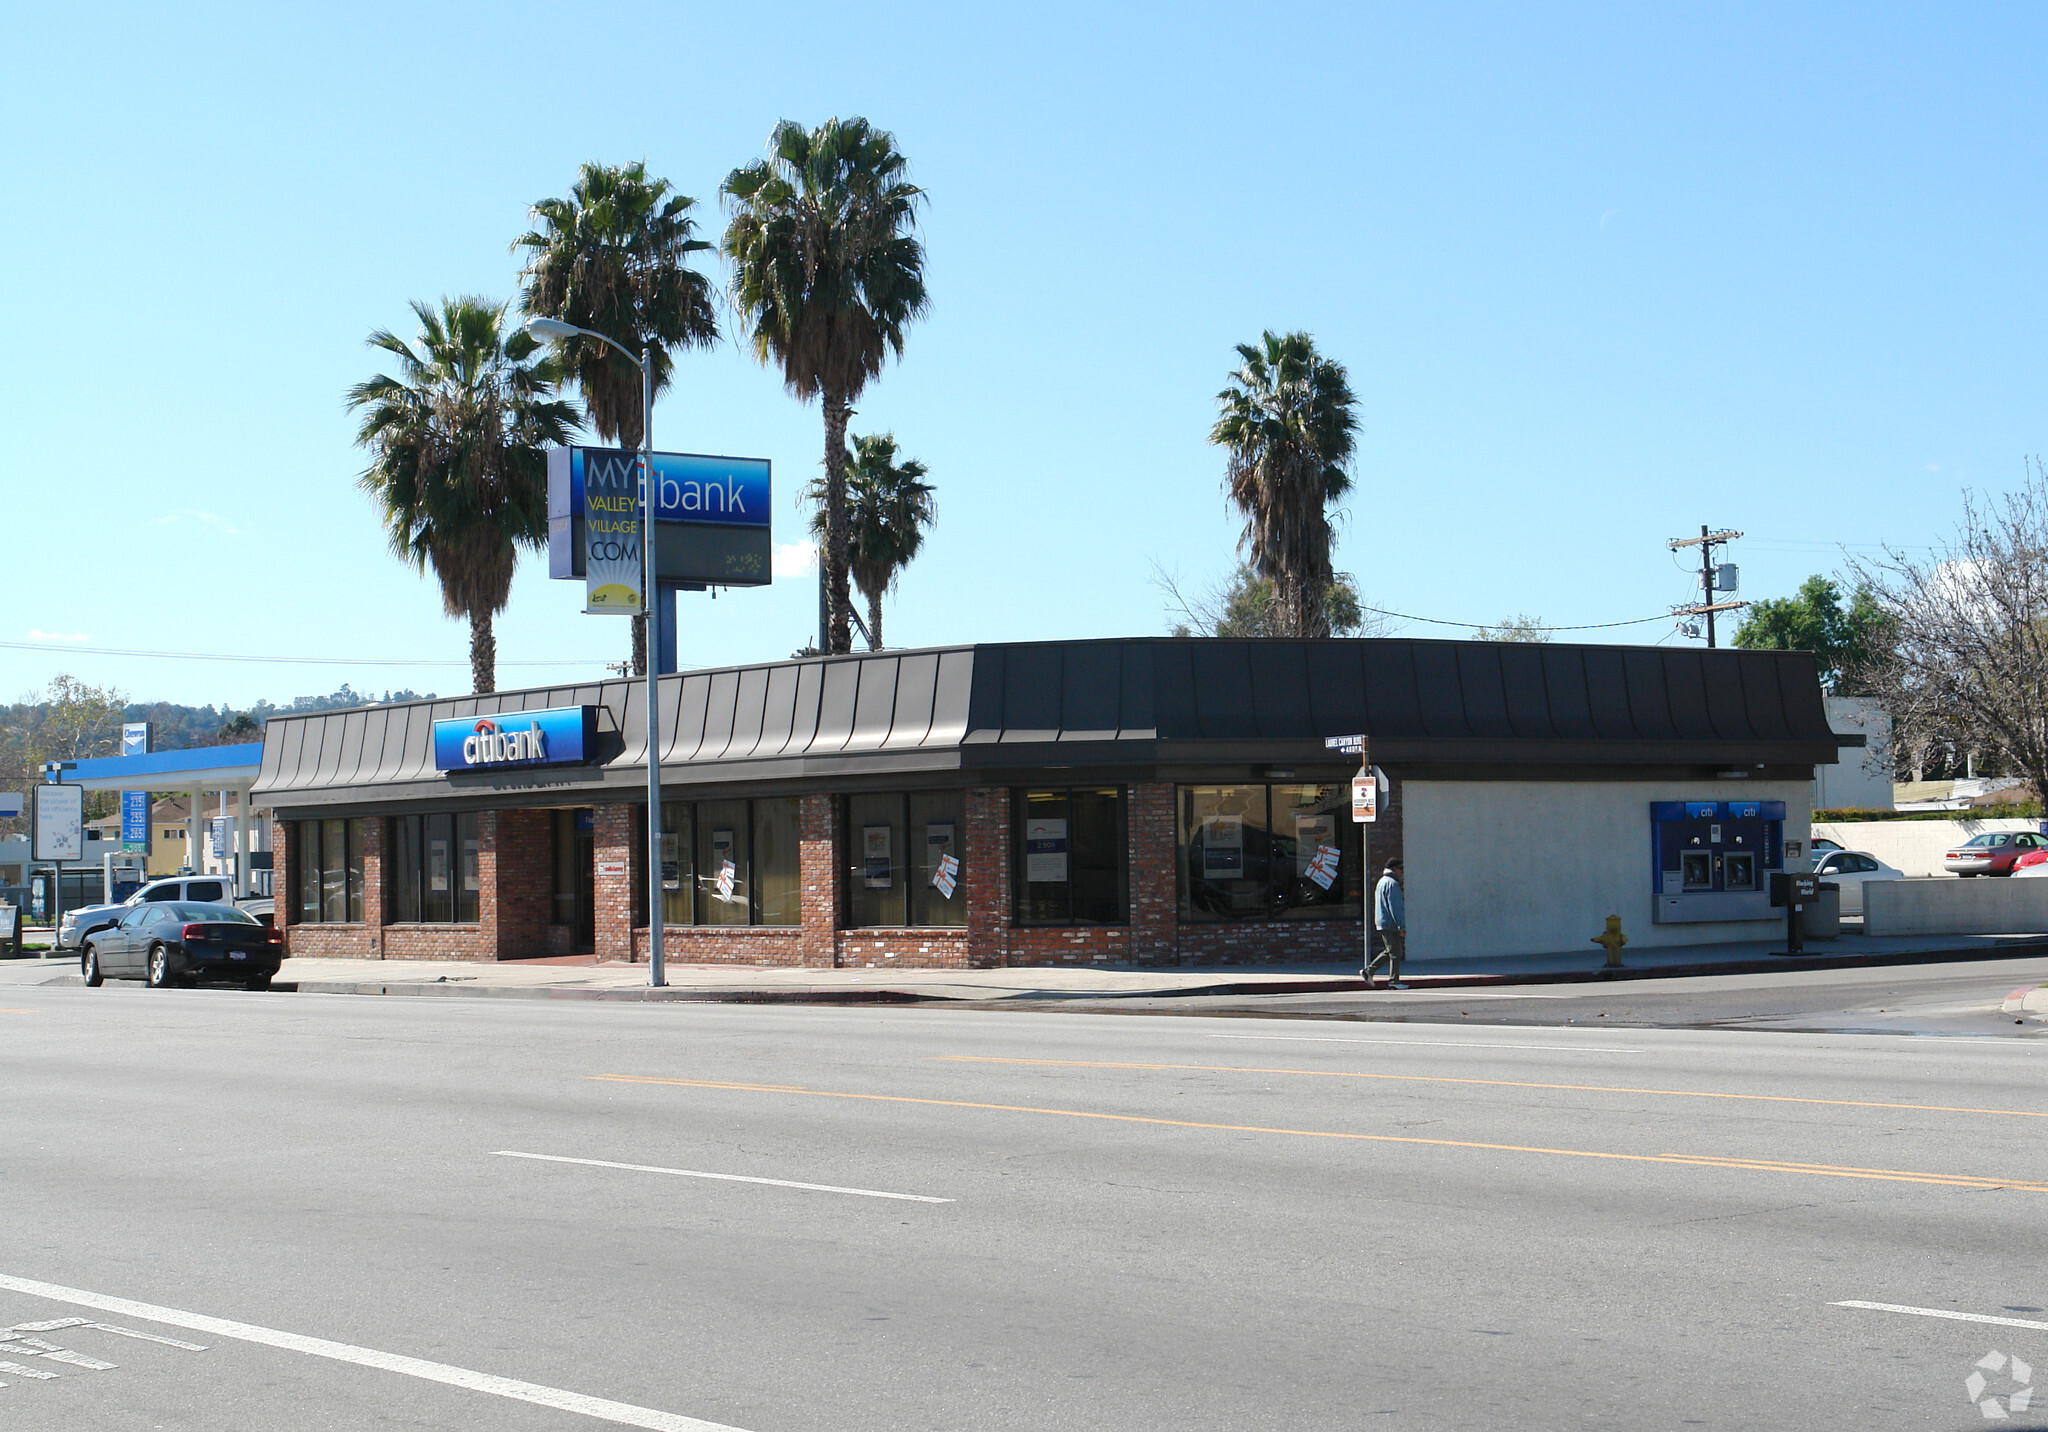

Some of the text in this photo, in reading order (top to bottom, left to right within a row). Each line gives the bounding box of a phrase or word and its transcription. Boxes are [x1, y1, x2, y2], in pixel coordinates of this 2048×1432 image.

[587, 456, 635, 489] MY
[587, 495, 636, 513] VALLEY
[588, 520, 638, 534] VILLAGE
[588, 541, 638, 561] .COM
[463, 719, 546, 765] citibank
[1700, 805, 1713, 817] citi
[1743, 805, 1756, 817] citi
